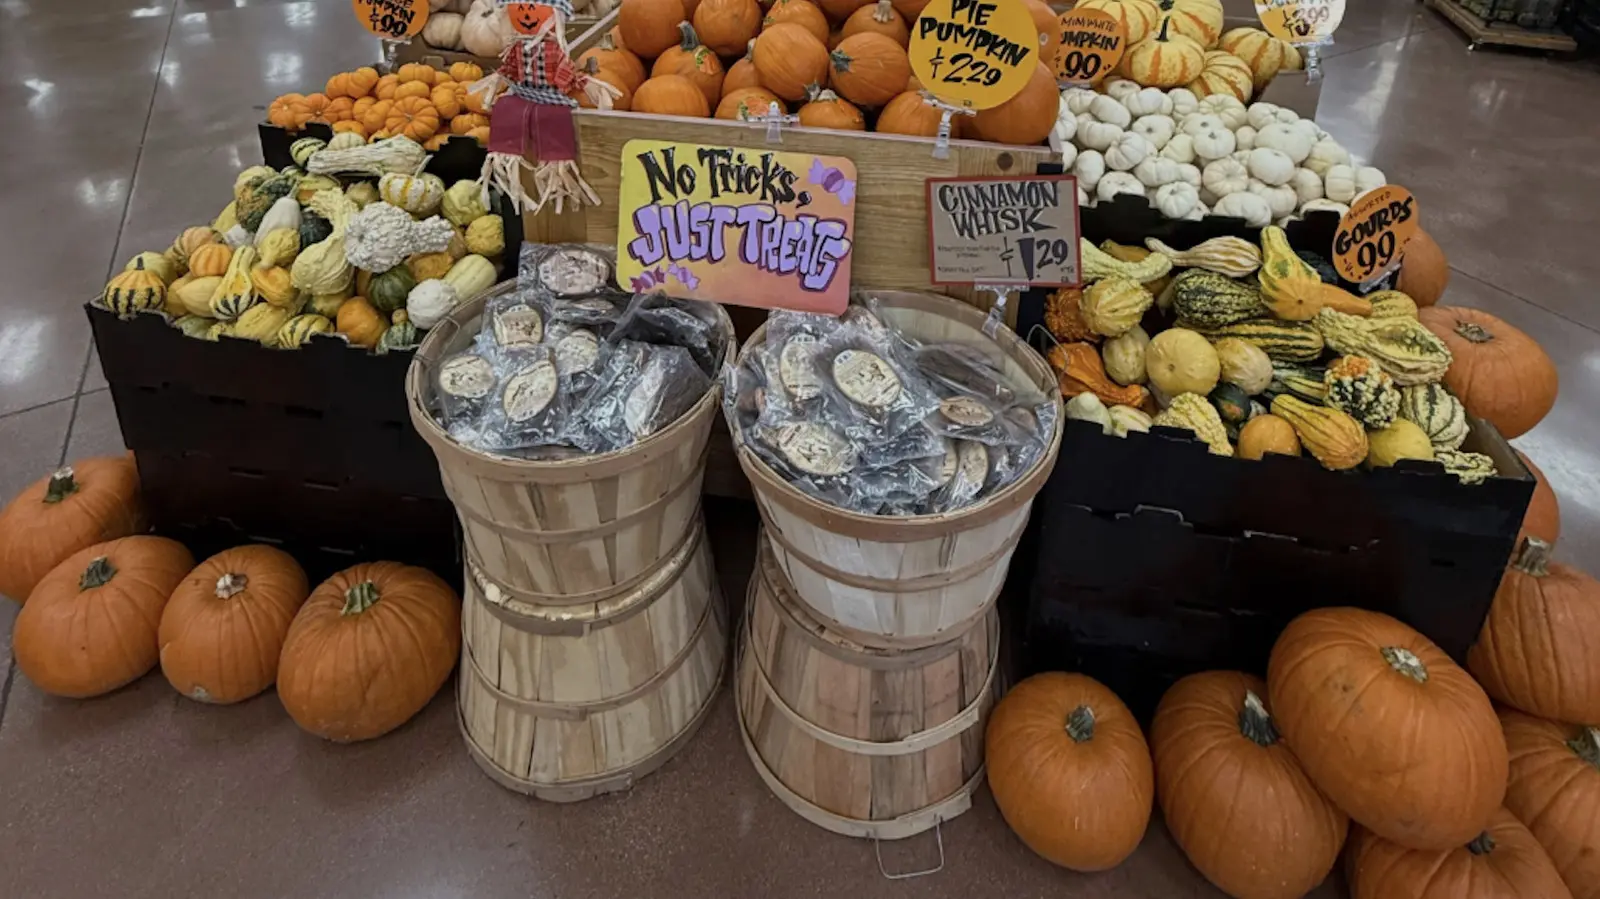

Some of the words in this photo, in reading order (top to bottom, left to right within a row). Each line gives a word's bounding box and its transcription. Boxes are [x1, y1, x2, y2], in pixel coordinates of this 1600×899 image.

[951, 0, 998, 26] PIE
[920, 17, 1030, 67] PUMPKIN
[636, 146, 697, 203] No
[697, 147, 813, 209] Tricks,
[937, 181, 1059, 213] CINNAMON
[627, 199, 738, 267] JUST
[735, 203, 852, 292] TREATS
[948, 207, 1058, 241] WHISK
[1335, 195, 1414, 256] GOURDS
